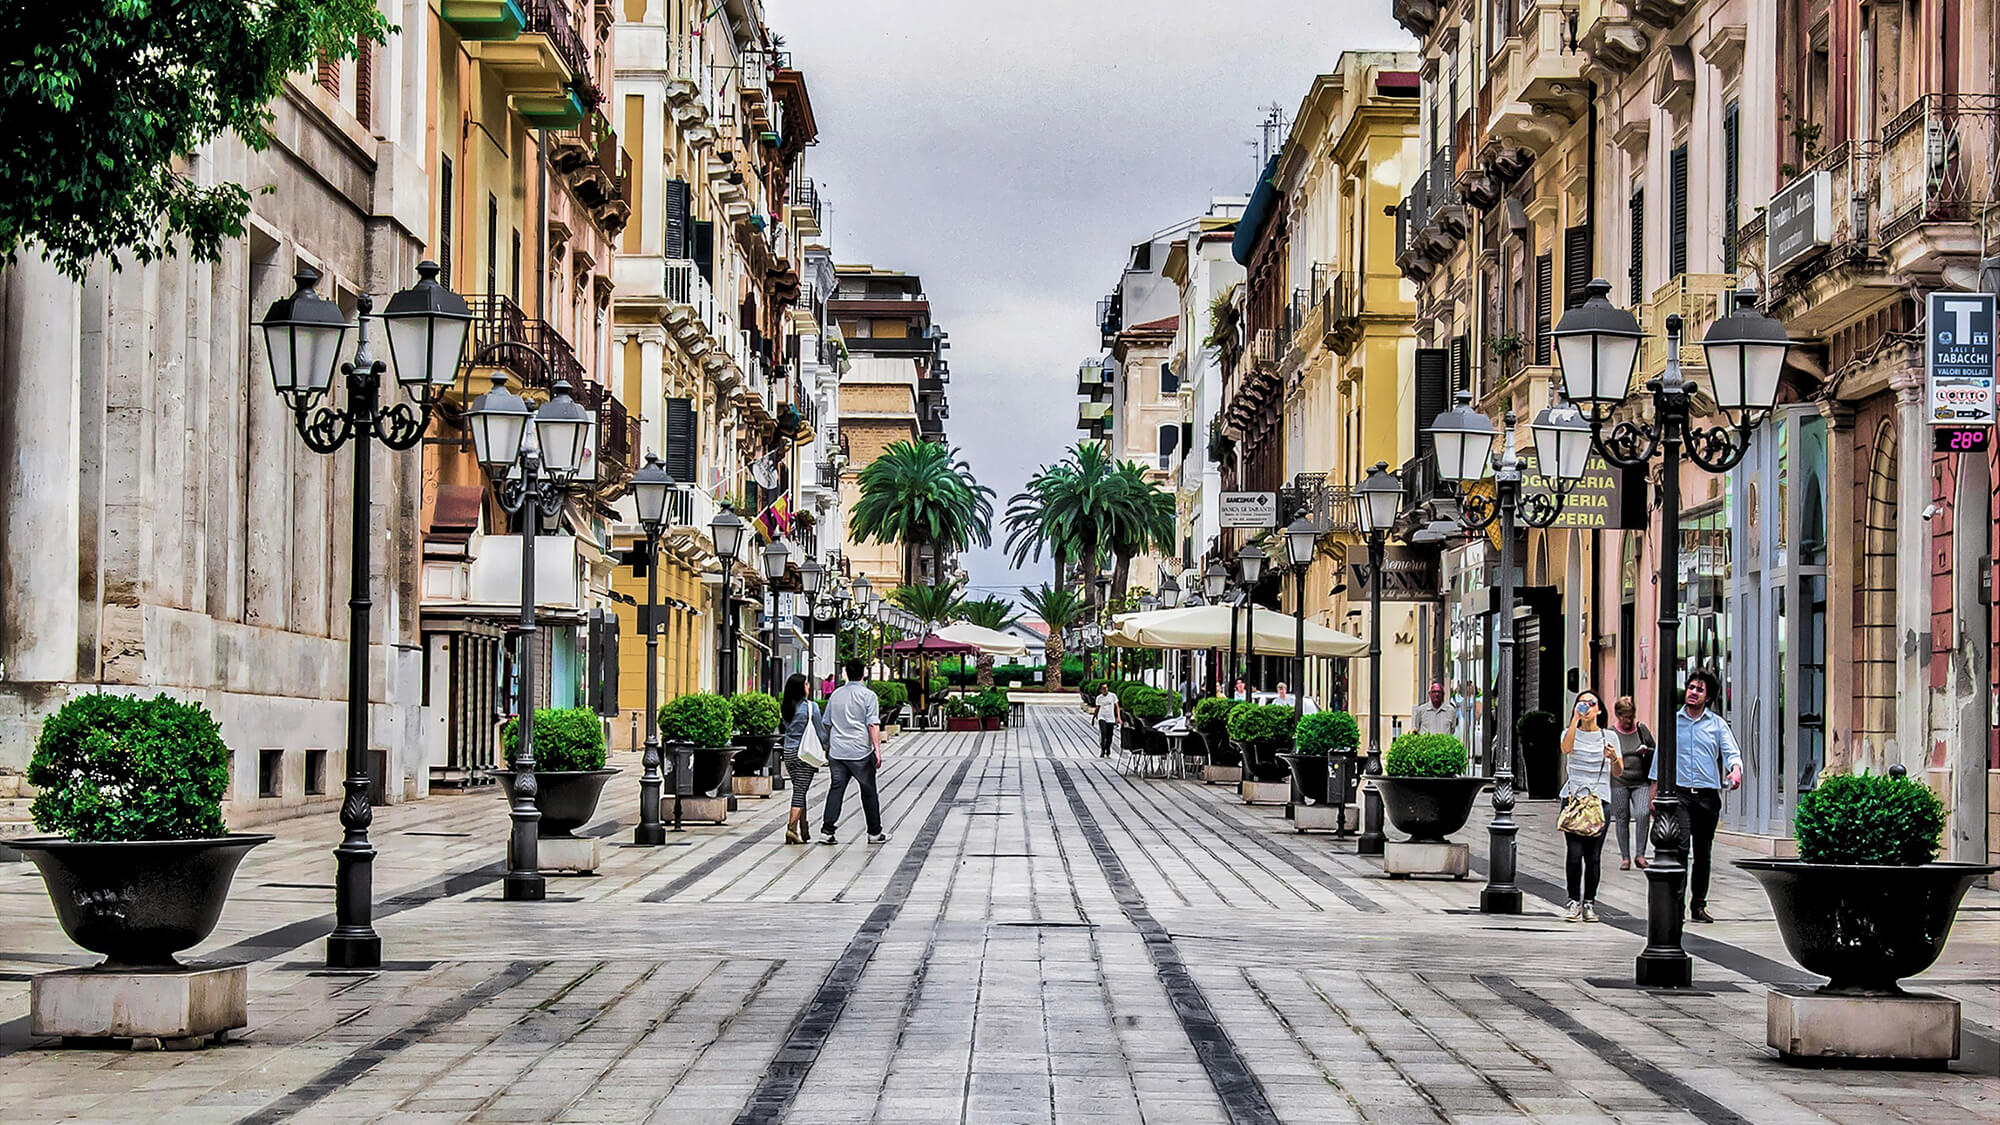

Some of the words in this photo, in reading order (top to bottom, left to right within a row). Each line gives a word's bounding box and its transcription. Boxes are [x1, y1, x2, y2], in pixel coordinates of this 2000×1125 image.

[1944, 301, 1983, 345] T
[1937, 353, 1988, 364] TABACCHI
[1937, 368, 1961, 376] VALORI
[1962, 368, 1988, 376] BOLLATI
[1939, 391, 1986, 400] LOTTO
[1350, 563, 1436, 590] VENNA
